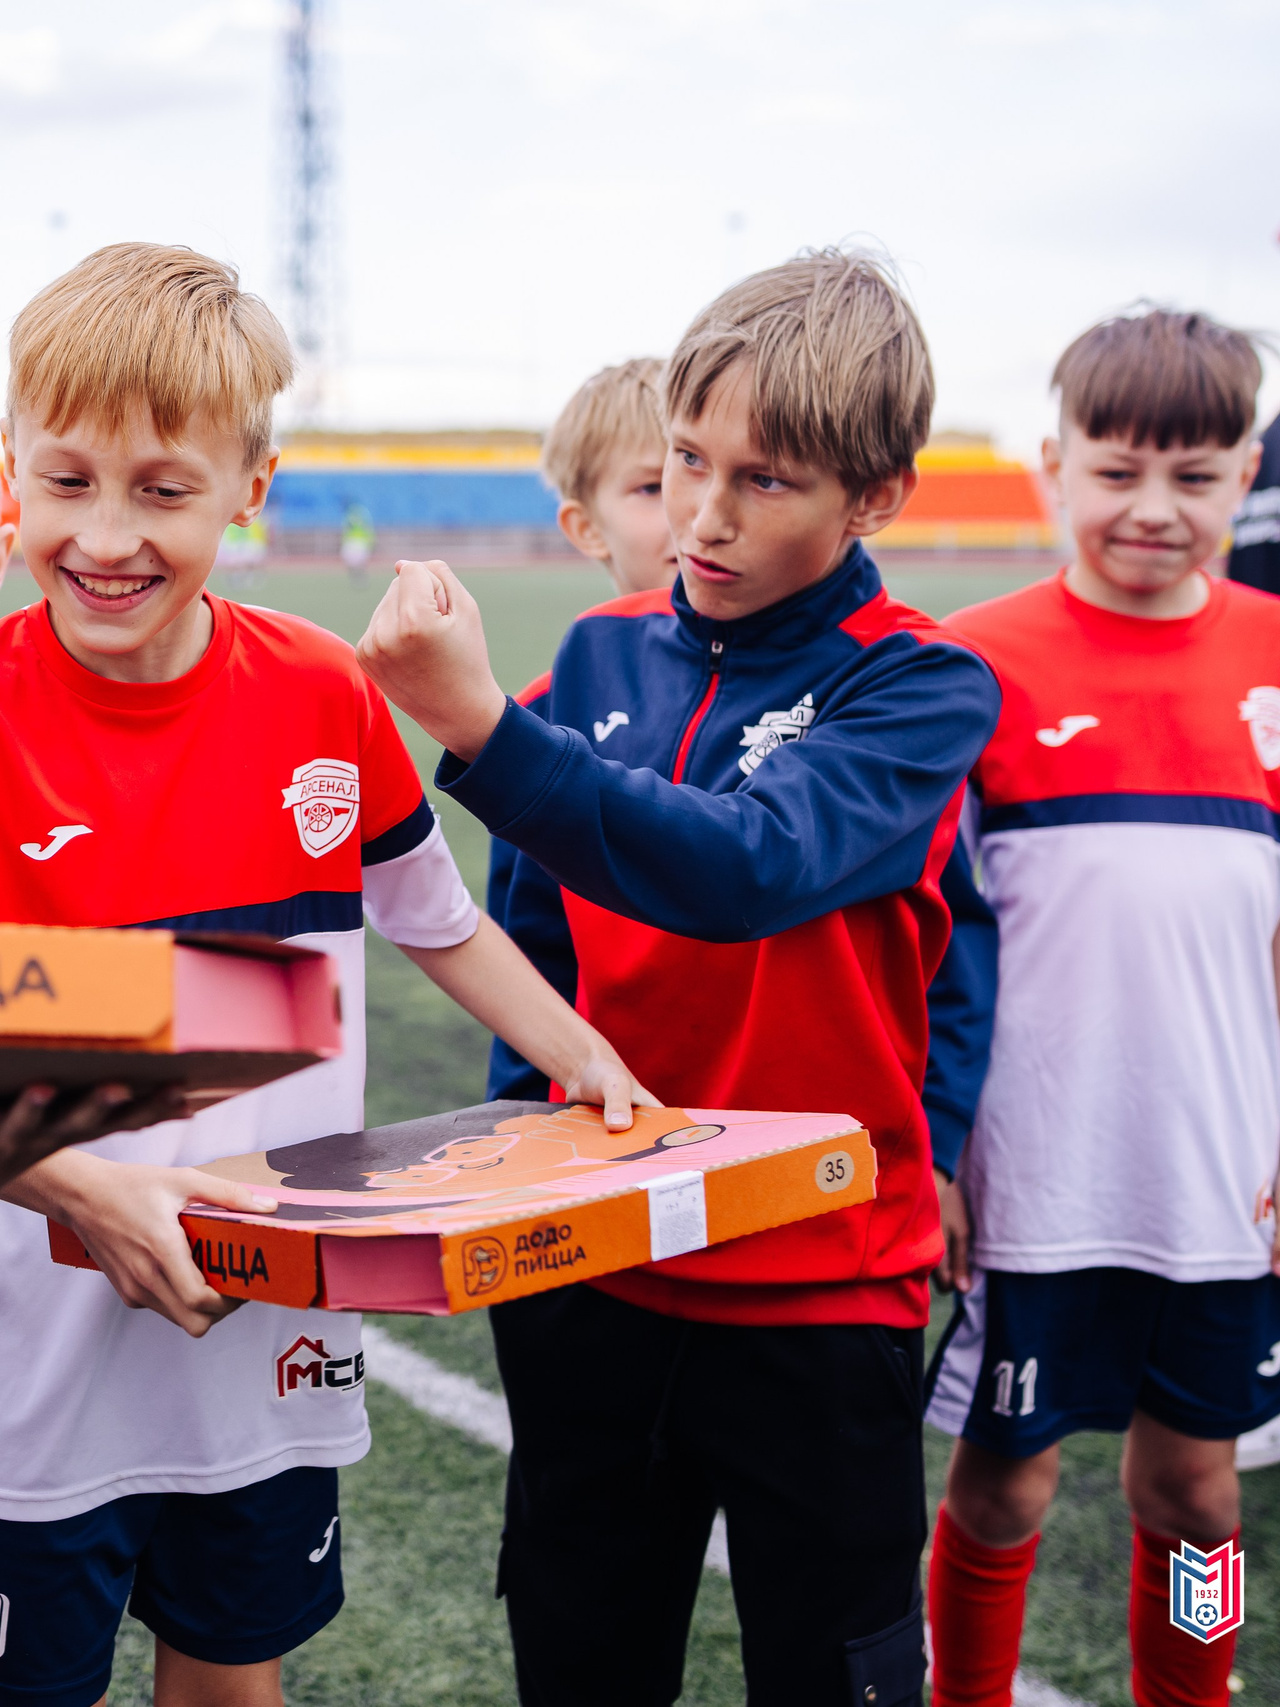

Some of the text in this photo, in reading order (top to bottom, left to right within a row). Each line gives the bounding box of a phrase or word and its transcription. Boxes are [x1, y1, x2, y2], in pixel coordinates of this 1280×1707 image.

[300, 780, 356, 799] АРСЕНАЛ
[825, 1158, 845, 1183] 35
[514, 1224, 572, 1255] ДОДО
[187, 1236, 269, 1287] ИЦЦА
[515, 1245, 587, 1278] ПИЦЦА
[992, 1357, 1038, 1417] 11
